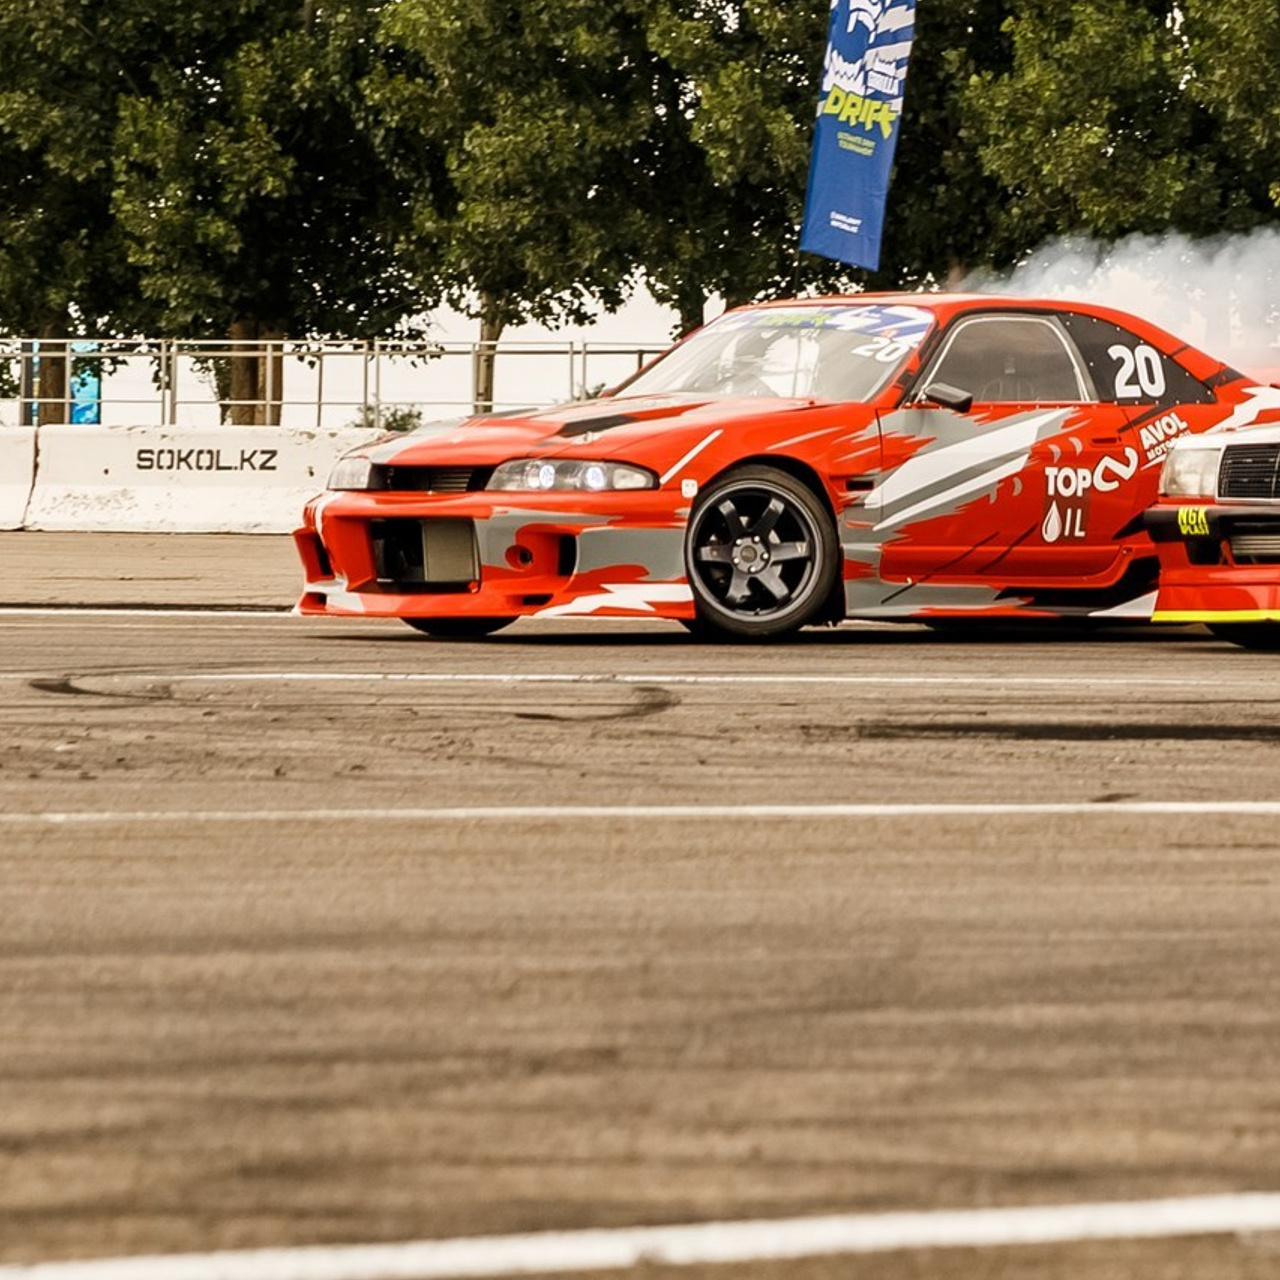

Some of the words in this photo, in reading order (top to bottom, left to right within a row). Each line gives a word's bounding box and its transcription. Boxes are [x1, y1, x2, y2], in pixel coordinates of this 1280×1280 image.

[822, 84, 898, 140] DRIFT
[852, 337, 910, 363] 20
[1107, 344, 1166, 398] 20
[136, 448, 278, 471] SOKOL.KZ
[1045, 466, 1092, 497] TOP
[1178, 507, 1208, 524] NGK
